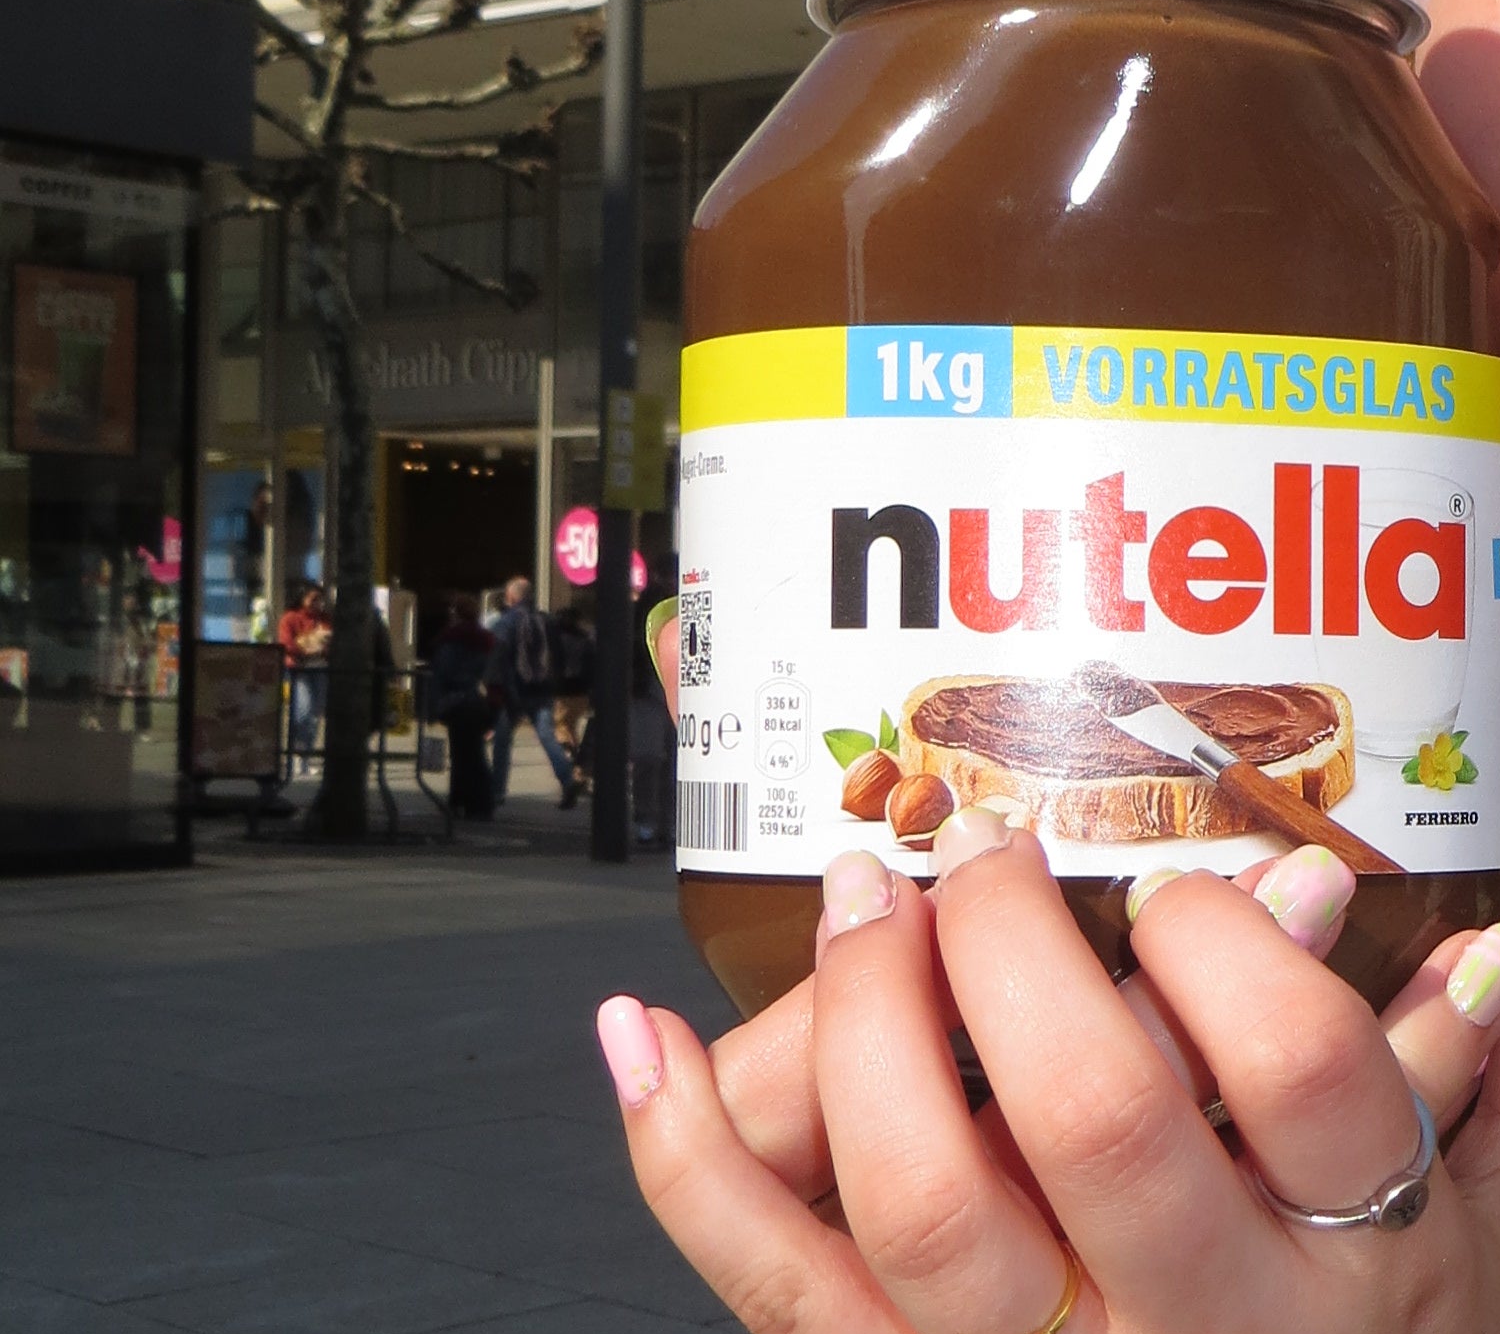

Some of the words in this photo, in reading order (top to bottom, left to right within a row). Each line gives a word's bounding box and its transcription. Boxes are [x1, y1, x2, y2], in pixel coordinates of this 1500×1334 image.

[877, 341, 985, 415] 1kg
[1043, 344, 1456, 422] VORRATSGLAS
[771, 661, 784, 673] 15
[786, 662, 797, 676] g:
[766, 697, 785, 710] 336
[788, 697, 800, 710] kJ
[764, 719, 777, 731] 80
[779, 718, 801, 731] kcal
[701, 719, 712, 756] g
[766, 788, 786, 801] 100
[788, 789, 799, 804] g:
[758, 805, 784, 818] 2252
[786, 805, 799, 818] kJ
[1405, 811, 1479, 826] FERRERO
[759, 822, 779, 835] 539
[781, 822, 803, 836] kcal
